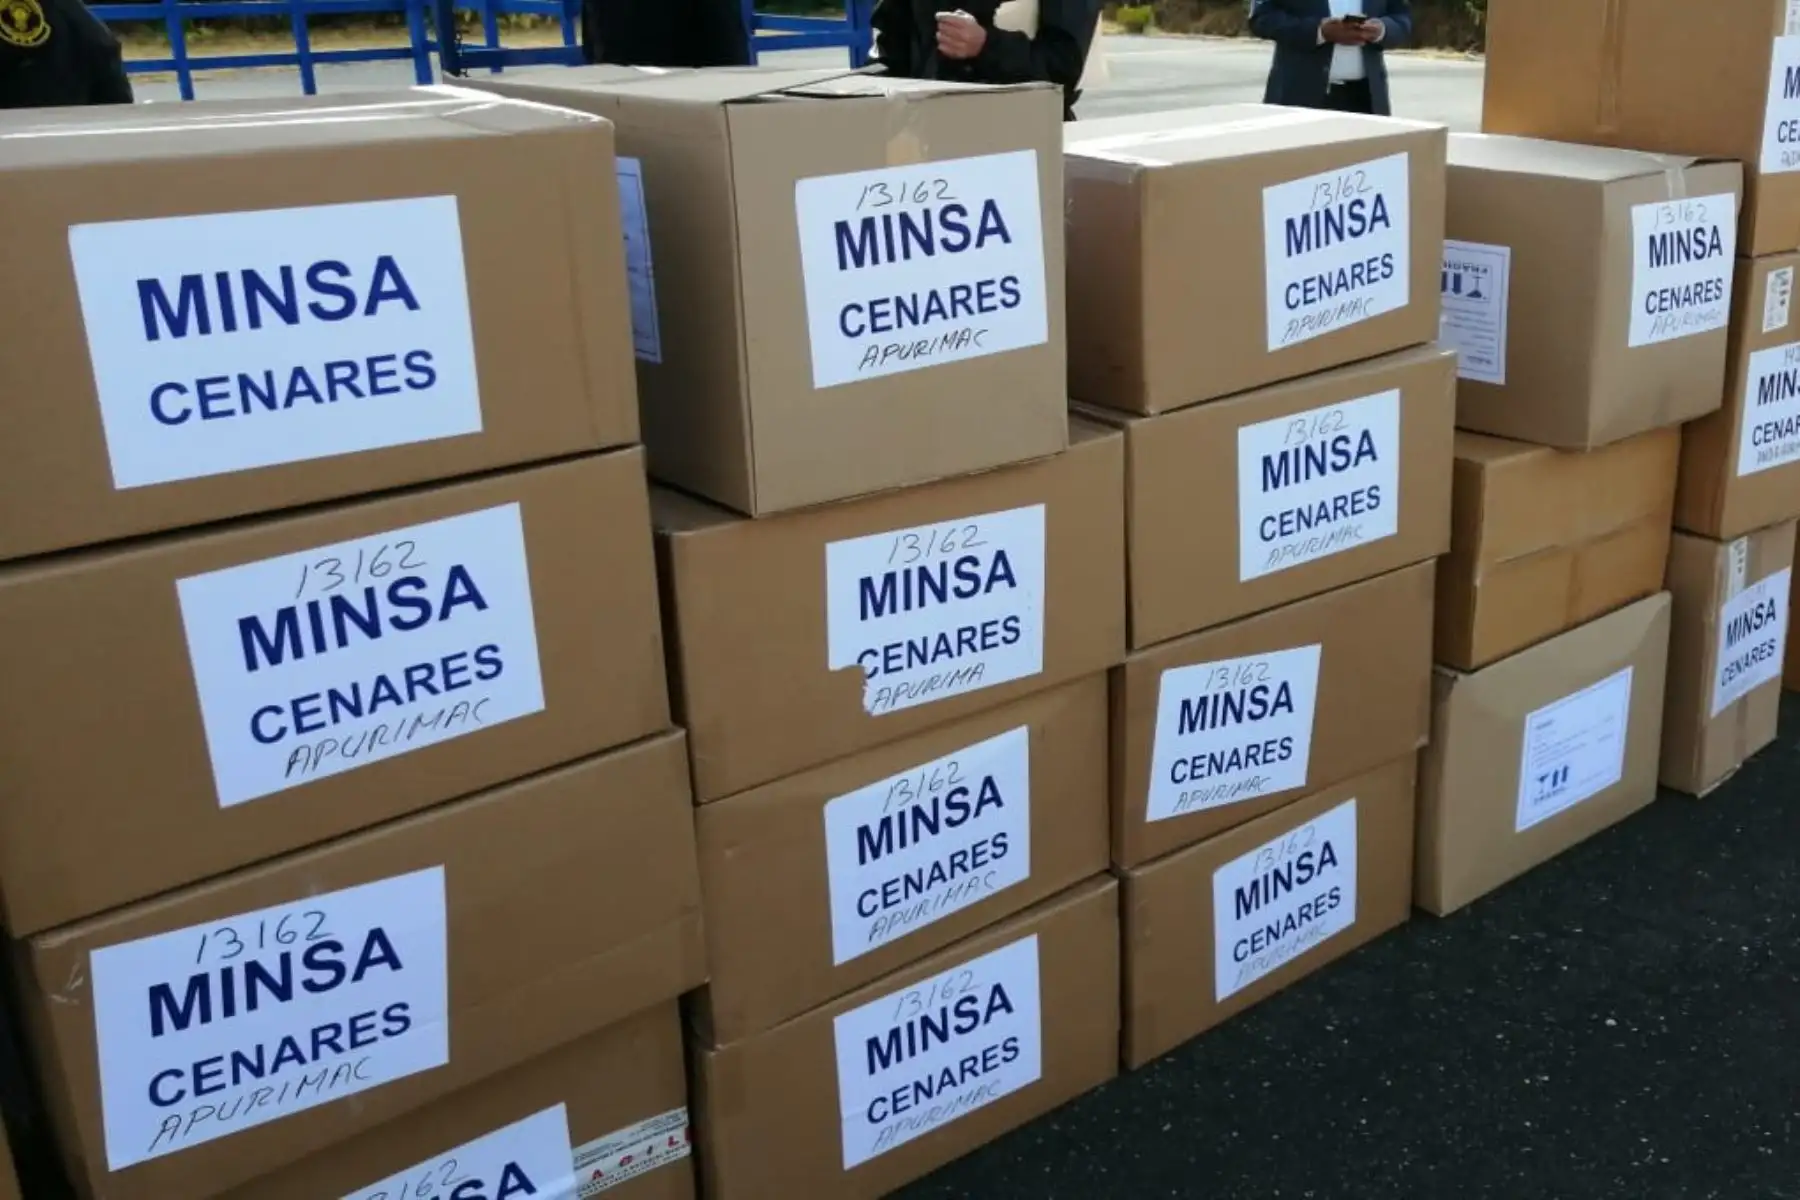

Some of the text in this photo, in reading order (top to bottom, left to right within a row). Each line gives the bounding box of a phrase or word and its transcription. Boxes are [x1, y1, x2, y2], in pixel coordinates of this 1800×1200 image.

[856, 179, 958, 210] 13162
[1310, 170, 1373, 210] 13162
[1654, 203, 1708, 232] 13162
[834, 199, 1011, 271] MINSA
[1285, 193, 1390, 258] MINSA
[1649, 225, 1723, 269] MINSA
[136, 255, 420, 341] MINSA
[839, 275, 1021, 338] CENARES
[1285, 253, 1394, 311] CENARES
[1645, 277, 1723, 315] CENARES
[858, 328, 988, 371] APURIMAC
[149, 350, 437, 425] CENARES
[1757, 367, 1800, 407] MIN
[1284, 410, 1349, 445] 13162
[1262, 428, 1378, 494] MINSA
[1260, 484, 1381, 542] CENARES
[295, 540, 427, 598] 13162
[889, 525, 988, 563] 13162
[859, 549, 1016, 620] MINSA
[238, 564, 488, 672] MINSA
[1726, 597, 1776, 649] MINSA
[1205, 662, 1272, 690] 13162
[1721, 638, 1776, 687] CENARES
[249, 644, 503, 744] CENARES
[1178, 679, 1294, 736] MINSA
[284, 697, 492, 778] APURIMAC
[1171, 736, 1293, 784] CENARES
[883, 761, 966, 812] 13162
[857, 775, 1004, 866] MINSA
[1253, 825, 1317, 873] 13162
[857, 832, 1008, 918] CENARES
[1235, 840, 1338, 921] MINSA
[868, 870, 996, 942] APURIMAC
[1233, 886, 1342, 962] CENARES
[197, 911, 333, 963] 13162
[149, 927, 403, 1038] MINSA
[894, 970, 982, 1020] 13162
[149, 1002, 411, 1107] CENARES
[866, 982, 1014, 1076] MINSA
[148, 1056, 373, 1152] APURIMAC
[867, 1036, 1020, 1124] CENARES
